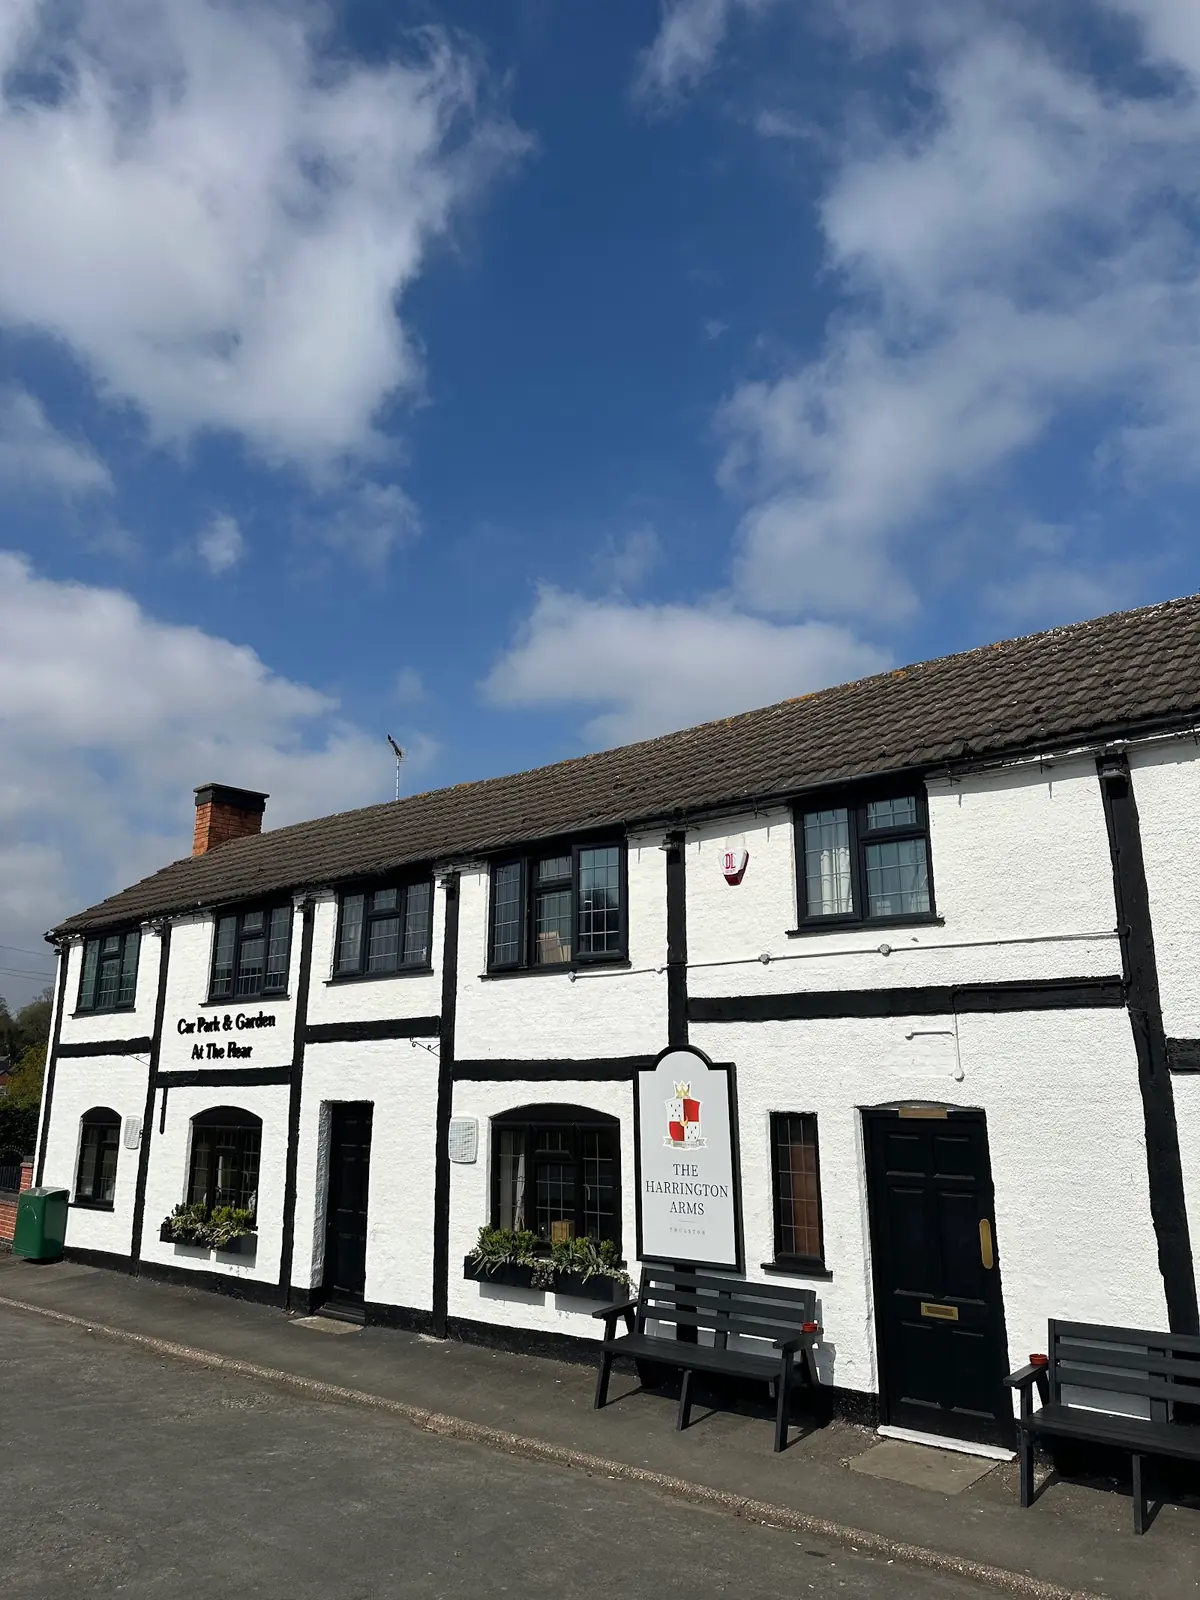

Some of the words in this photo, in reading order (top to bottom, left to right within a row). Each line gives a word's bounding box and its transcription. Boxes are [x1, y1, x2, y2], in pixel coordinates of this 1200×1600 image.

[725, 853, 736, 869] DL
[177, 1018, 197, 1035] Car
[197, 1016, 220, 1033] Park
[222, 1014, 233, 1032] &
[235, 1011, 276, 1030] Garden
[191, 1043, 205, 1060] At
[206, 1042, 225, 1060] The
[227, 1041, 253, 1059] Rear
[672, 1163, 699, 1177] THE
[645, 1180, 728, 1197] HARRINGTON
[669, 1201, 705, 1215] ARMS
